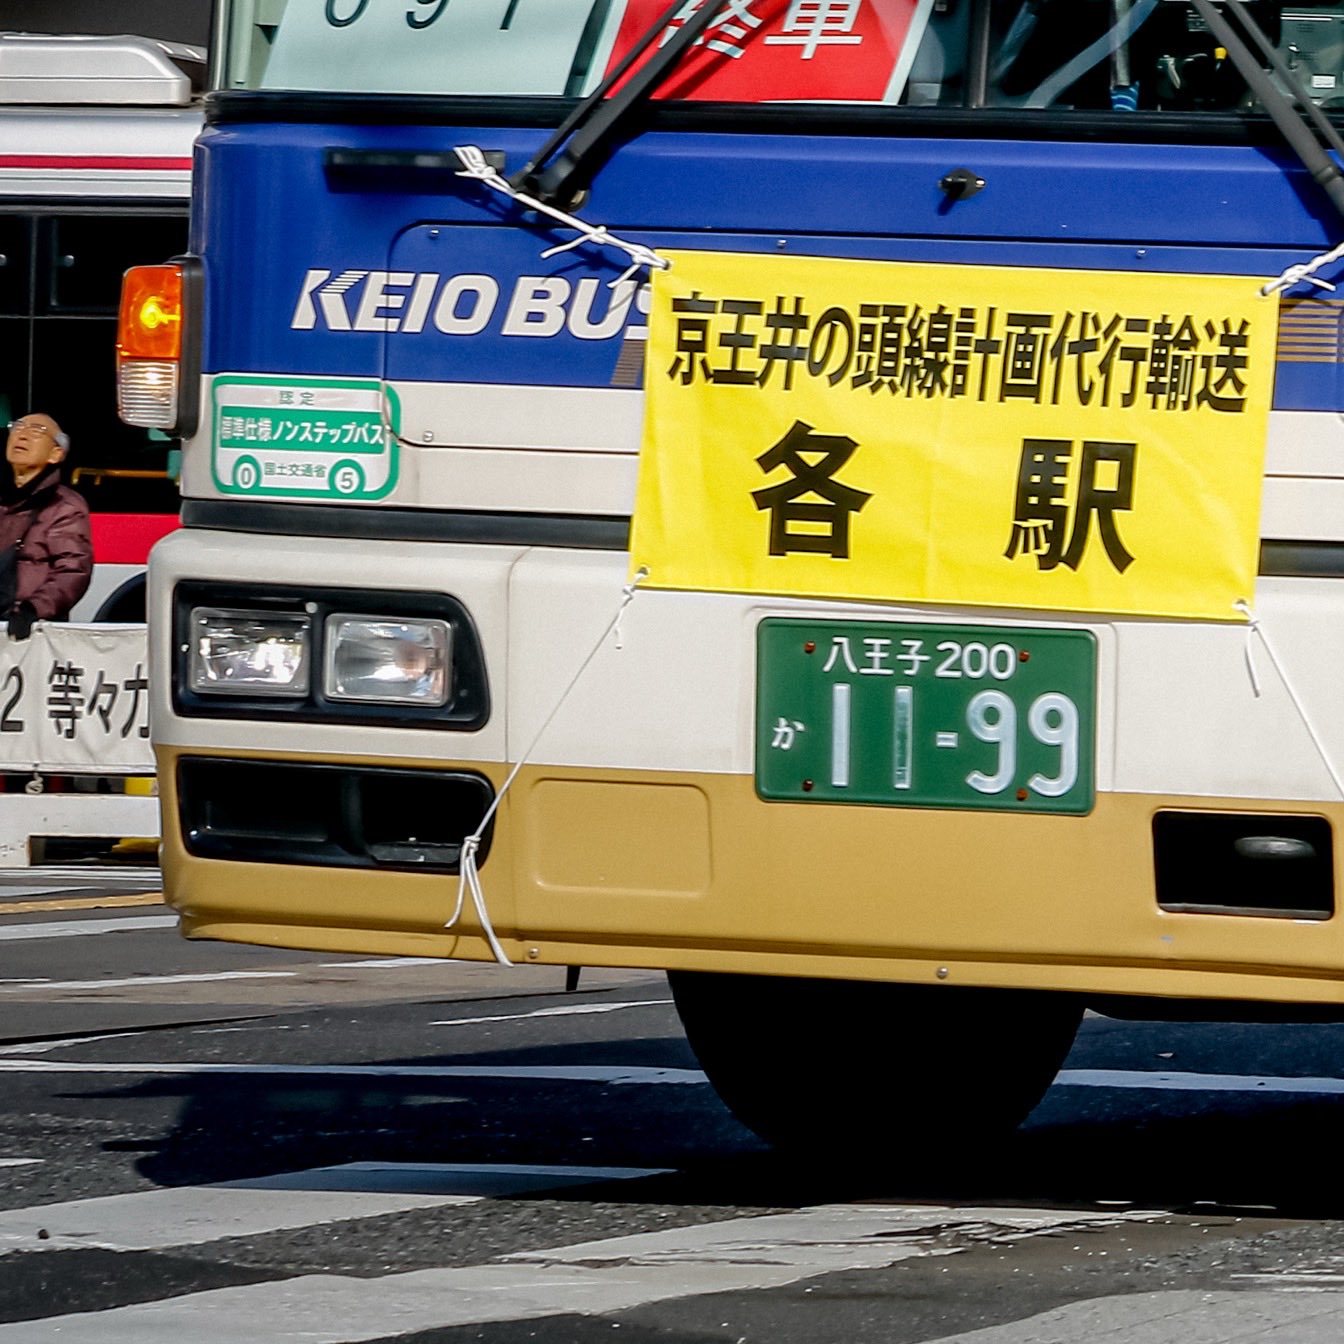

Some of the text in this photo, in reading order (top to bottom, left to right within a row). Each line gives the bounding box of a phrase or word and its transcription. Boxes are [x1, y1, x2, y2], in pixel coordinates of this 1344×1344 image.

[290, 269, 651, 340] KEIO BU
[668, 290, 1252, 413] 京王井の頭線計画代行輸送
[263, 462, 328, 479] 国土交通省
[340, 471, 353, 490] 5
[750, 419, 1140, 575] 各駅
[47, 659, 149, 739] 等々力
[771, 717, 805, 750] か
